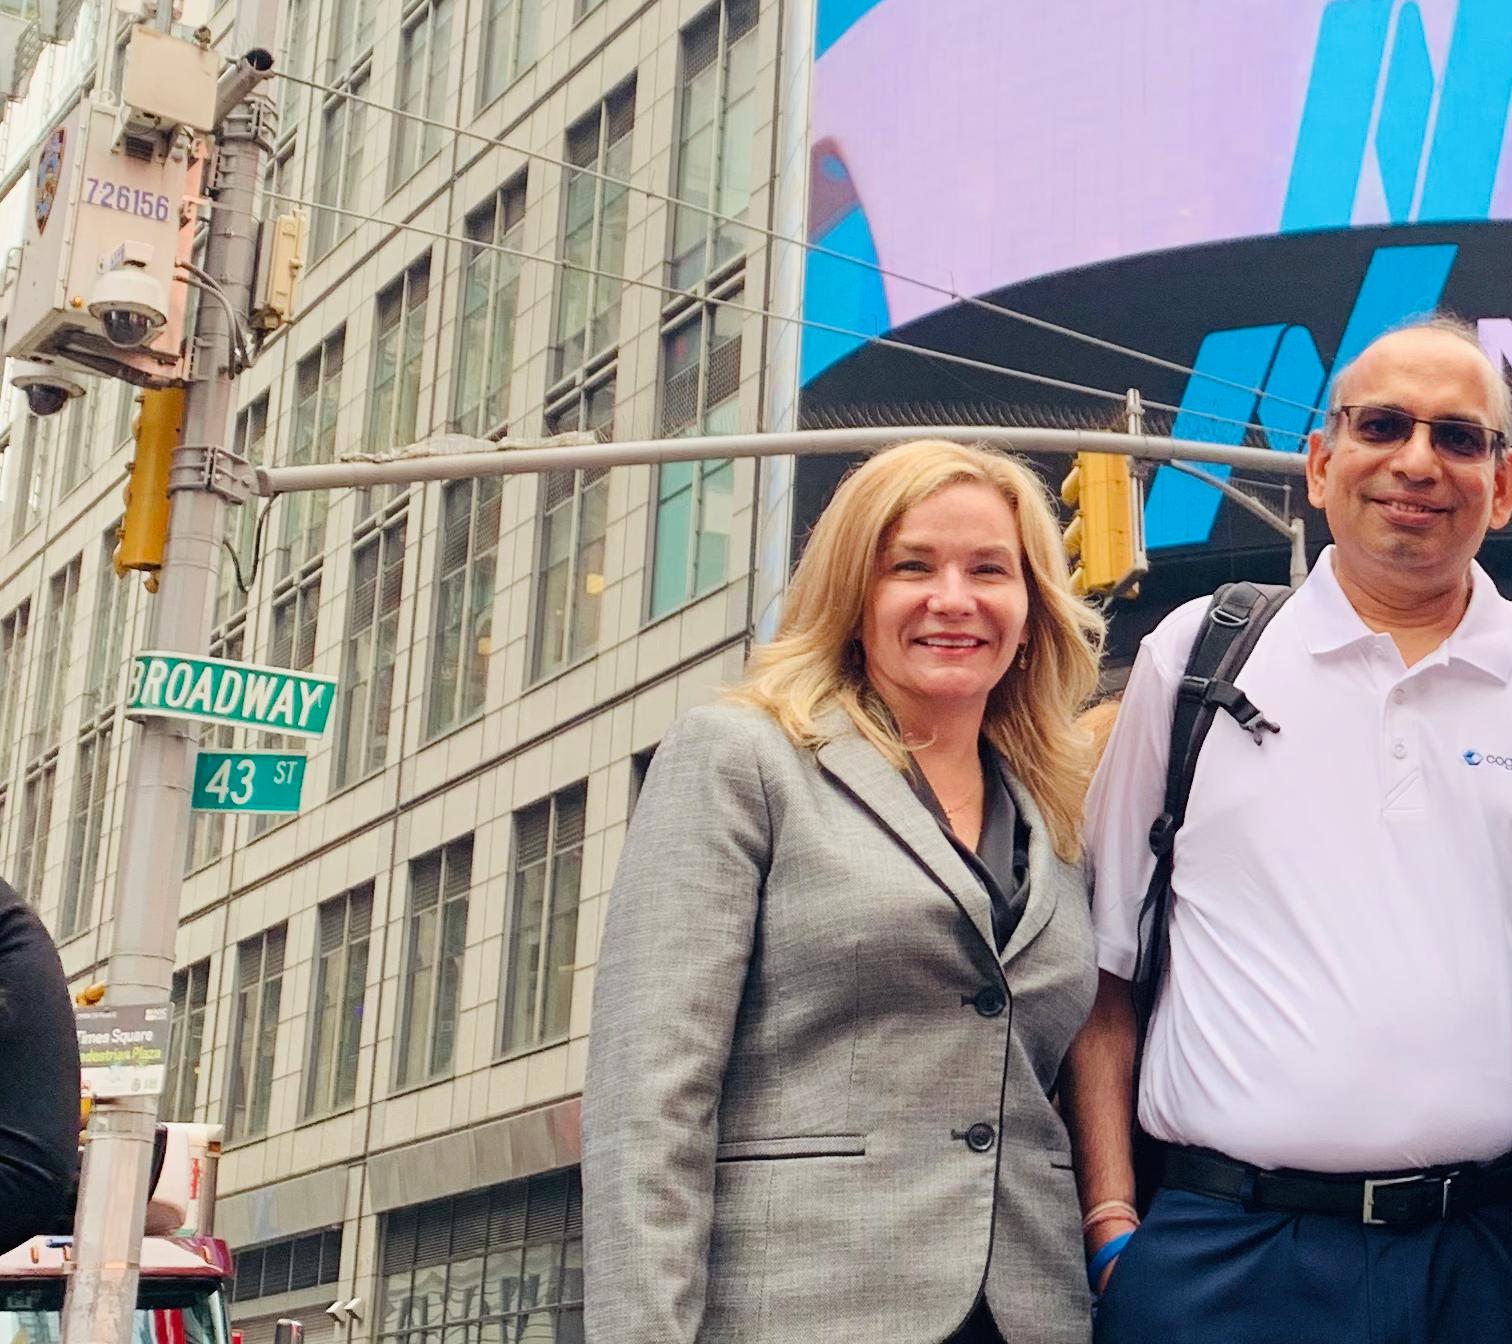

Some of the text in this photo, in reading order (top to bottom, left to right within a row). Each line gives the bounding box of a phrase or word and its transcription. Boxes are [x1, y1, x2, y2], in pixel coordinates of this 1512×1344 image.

[87, 177, 169, 223] 726156
[127, 659, 326, 727] BROADWAY
[205, 759, 298, 805] 43 ST
[112, 1028, 153, 1045] Square
